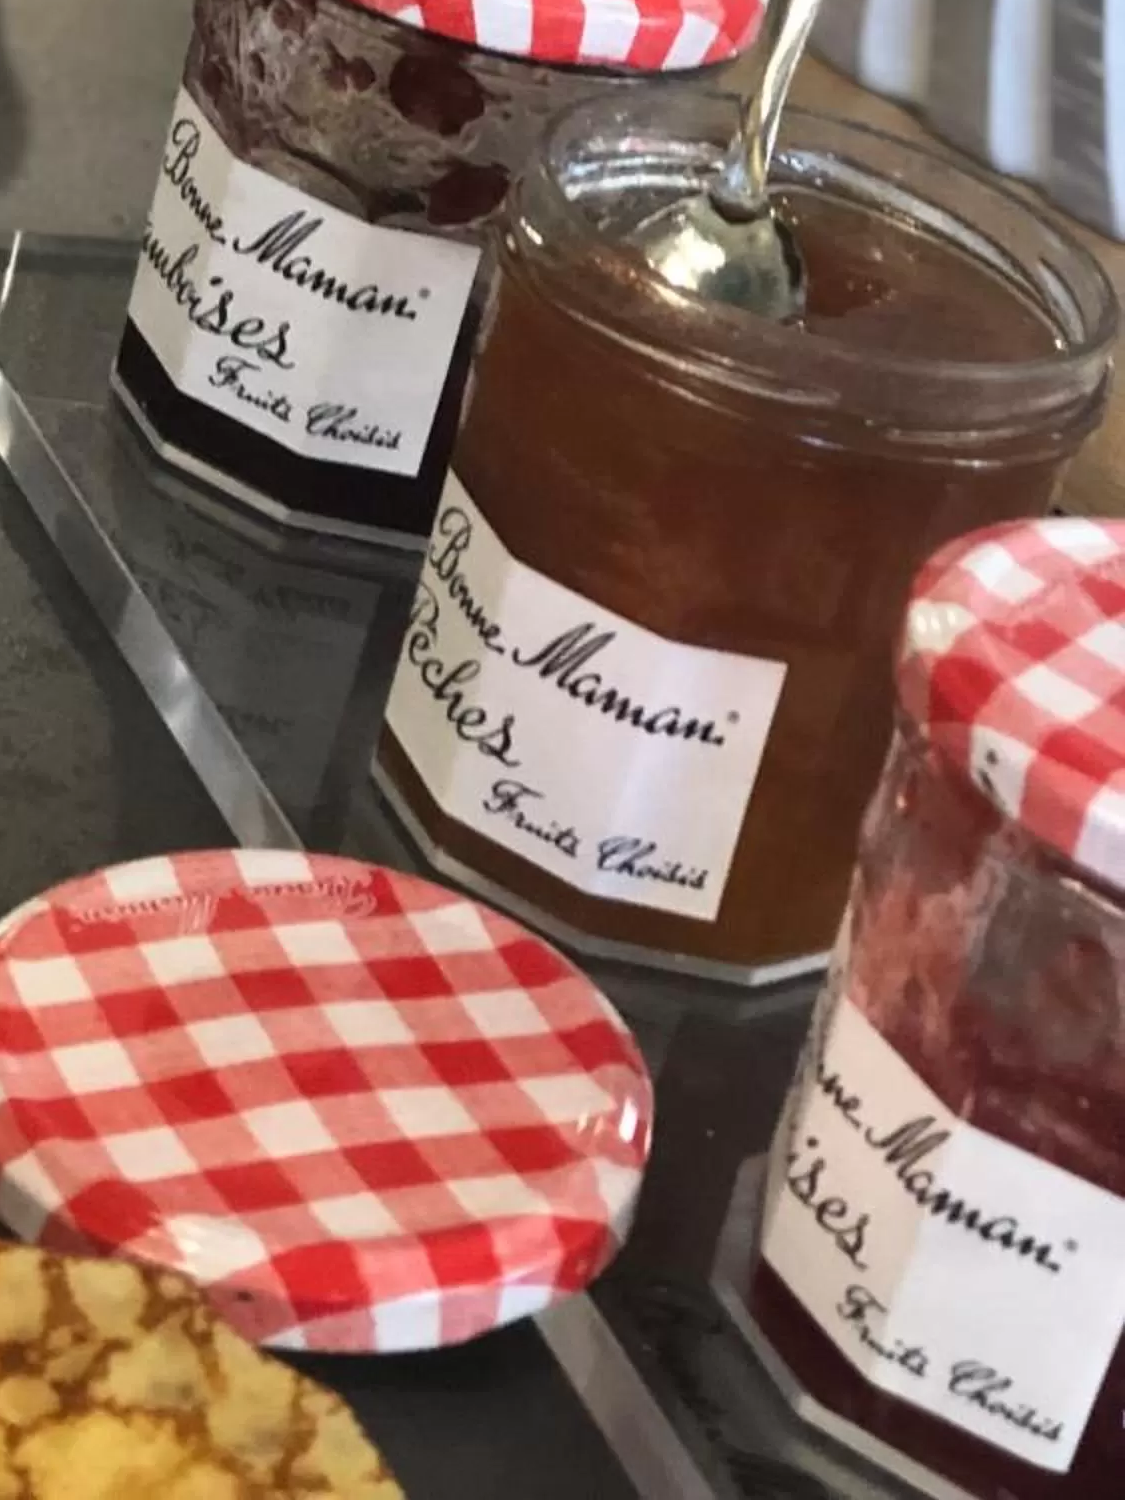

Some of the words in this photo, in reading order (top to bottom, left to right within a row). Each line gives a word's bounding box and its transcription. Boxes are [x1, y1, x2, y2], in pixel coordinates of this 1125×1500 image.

[164, 118, 227, 245] Bonne
[232, 210, 418, 320] Maman
[208, 355, 292, 422] Fruits
[428, 505, 506, 656] Bonne
[511, 621, 727, 747] Maman
[482, 778, 583, 859] Fruits
[835, 1283, 931, 1379] Fruits
